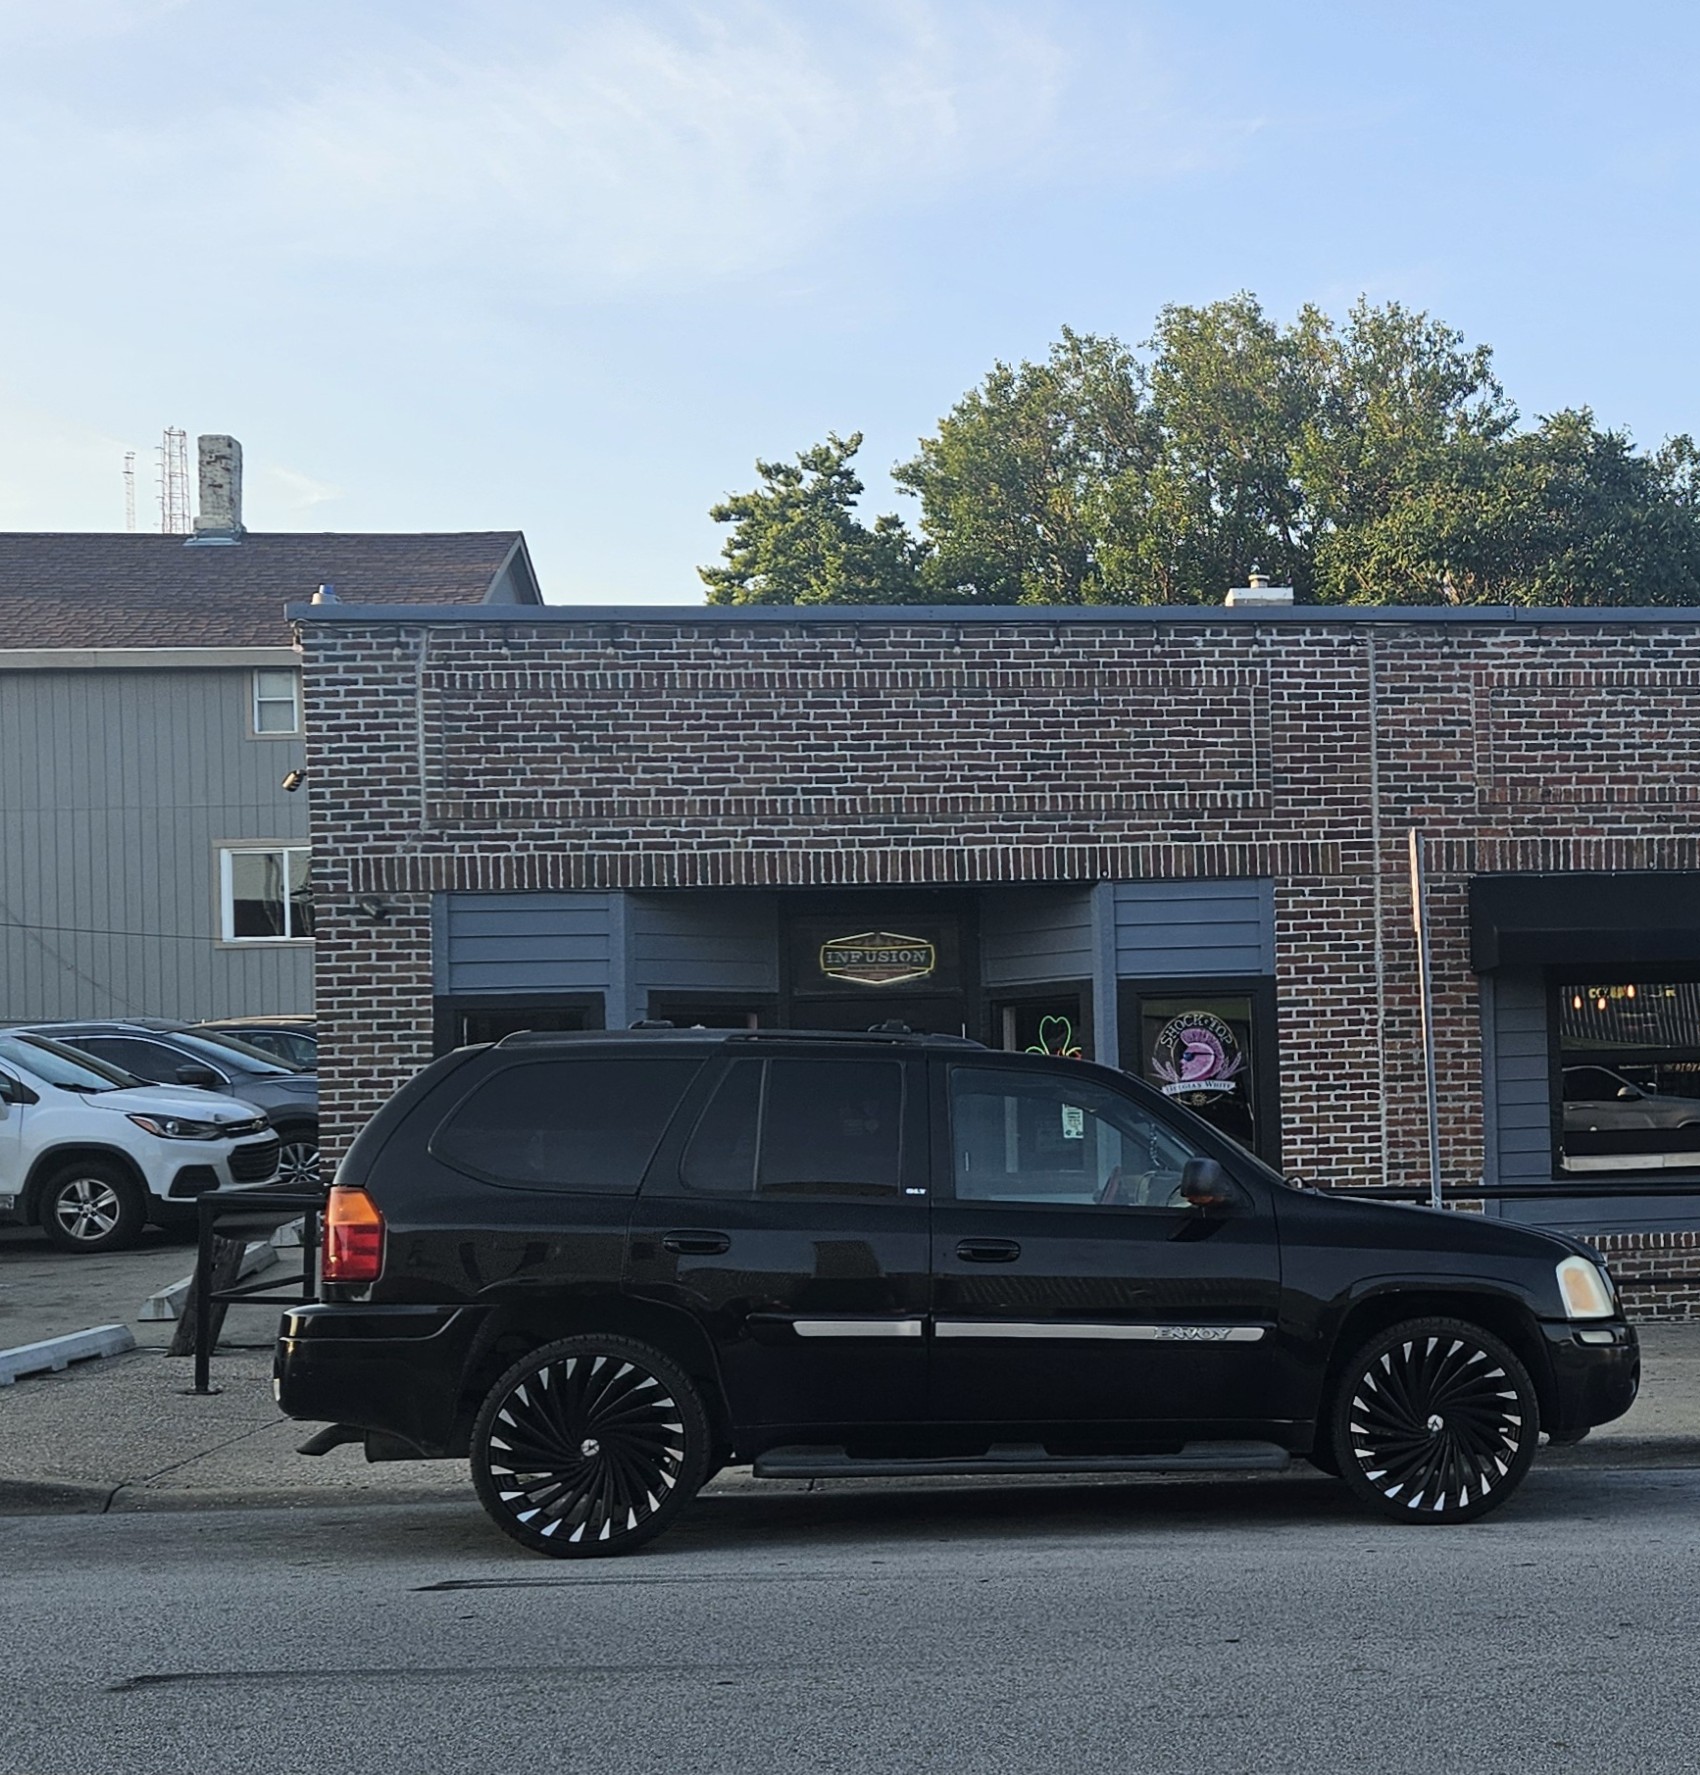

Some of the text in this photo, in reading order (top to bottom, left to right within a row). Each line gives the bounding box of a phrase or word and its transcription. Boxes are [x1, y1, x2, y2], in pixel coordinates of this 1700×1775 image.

[826, 950, 926, 963] INFUSION
[1160, 1014, 1233, 1049] SHOCK TOP
[1158, 1326, 1232, 1340] ENVOY
